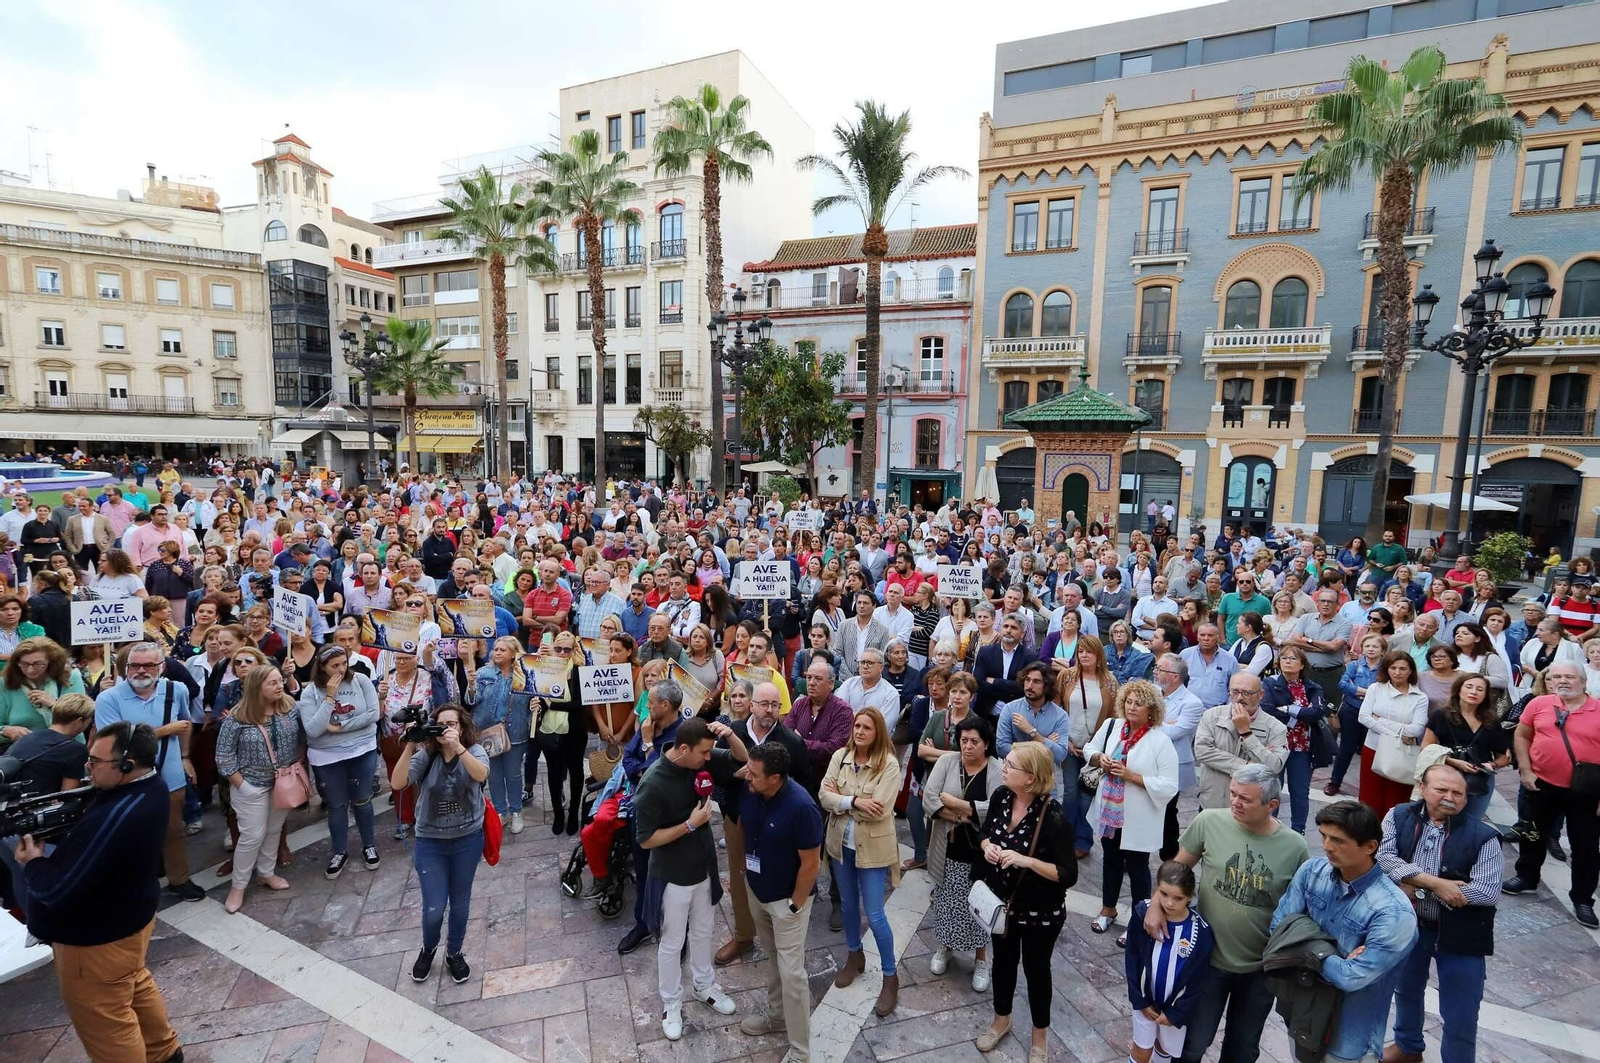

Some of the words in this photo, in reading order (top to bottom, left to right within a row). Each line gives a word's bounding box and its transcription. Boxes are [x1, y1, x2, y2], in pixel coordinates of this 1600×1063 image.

[453, 411, 475, 420] Plaza
[753, 565, 777, 573] AVE
[282, 593, 297, 606] AVE
[90, 604, 124, 615] AVE
[281, 604, 304, 618] HUELVA
[90, 615, 138, 625] HUELVA
[283, 613, 296, 624] YA!!!
[95, 626, 121, 634] YA!!!
[593, 668, 618, 678] AVE
[593, 679, 629, 687] HUELVA
